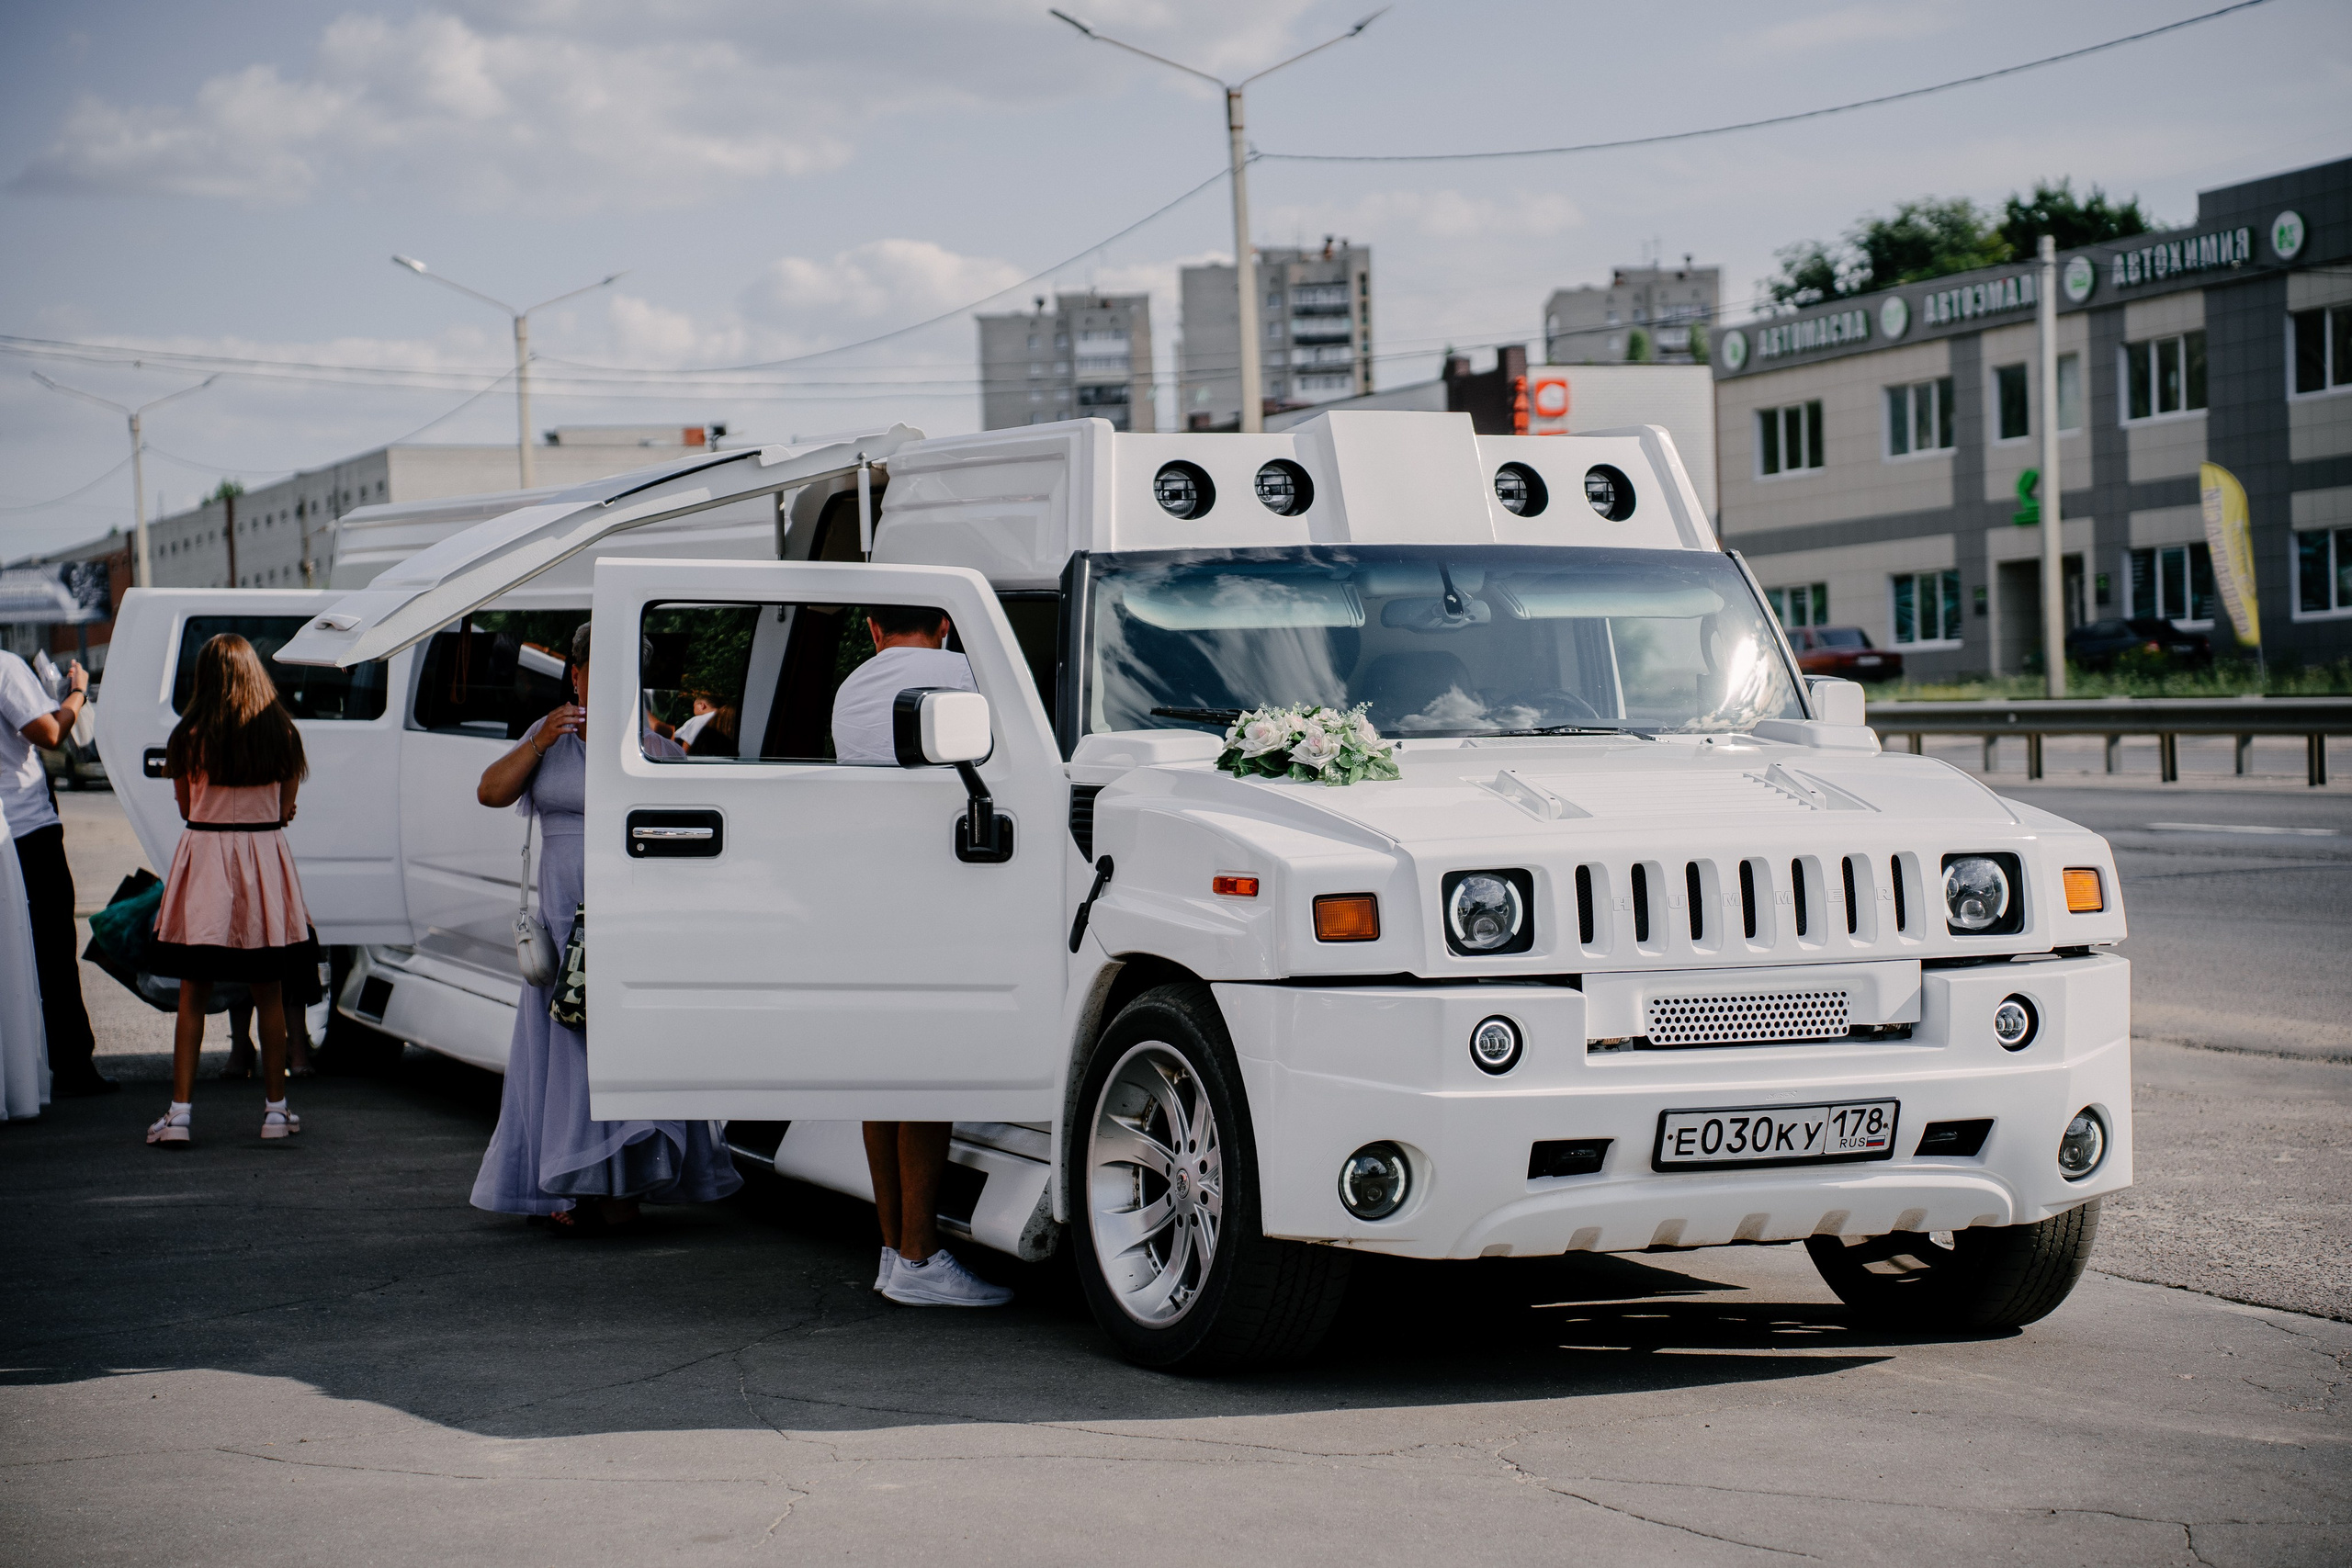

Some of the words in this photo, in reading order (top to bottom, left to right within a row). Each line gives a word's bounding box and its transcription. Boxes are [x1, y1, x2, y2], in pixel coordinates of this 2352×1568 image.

[1758, 310, 1868, 355] АВТОМАСЛА
[1924, 274, 2041, 323] АВТОЭМАЛ
[2112, 227, 2250, 284] АВТОХИМИЯ
[1612, 887, 1893, 911] HUMMER
[1832, 1108, 1883, 1137] 178
[1839, 1137, 1866, 1149] RUS
